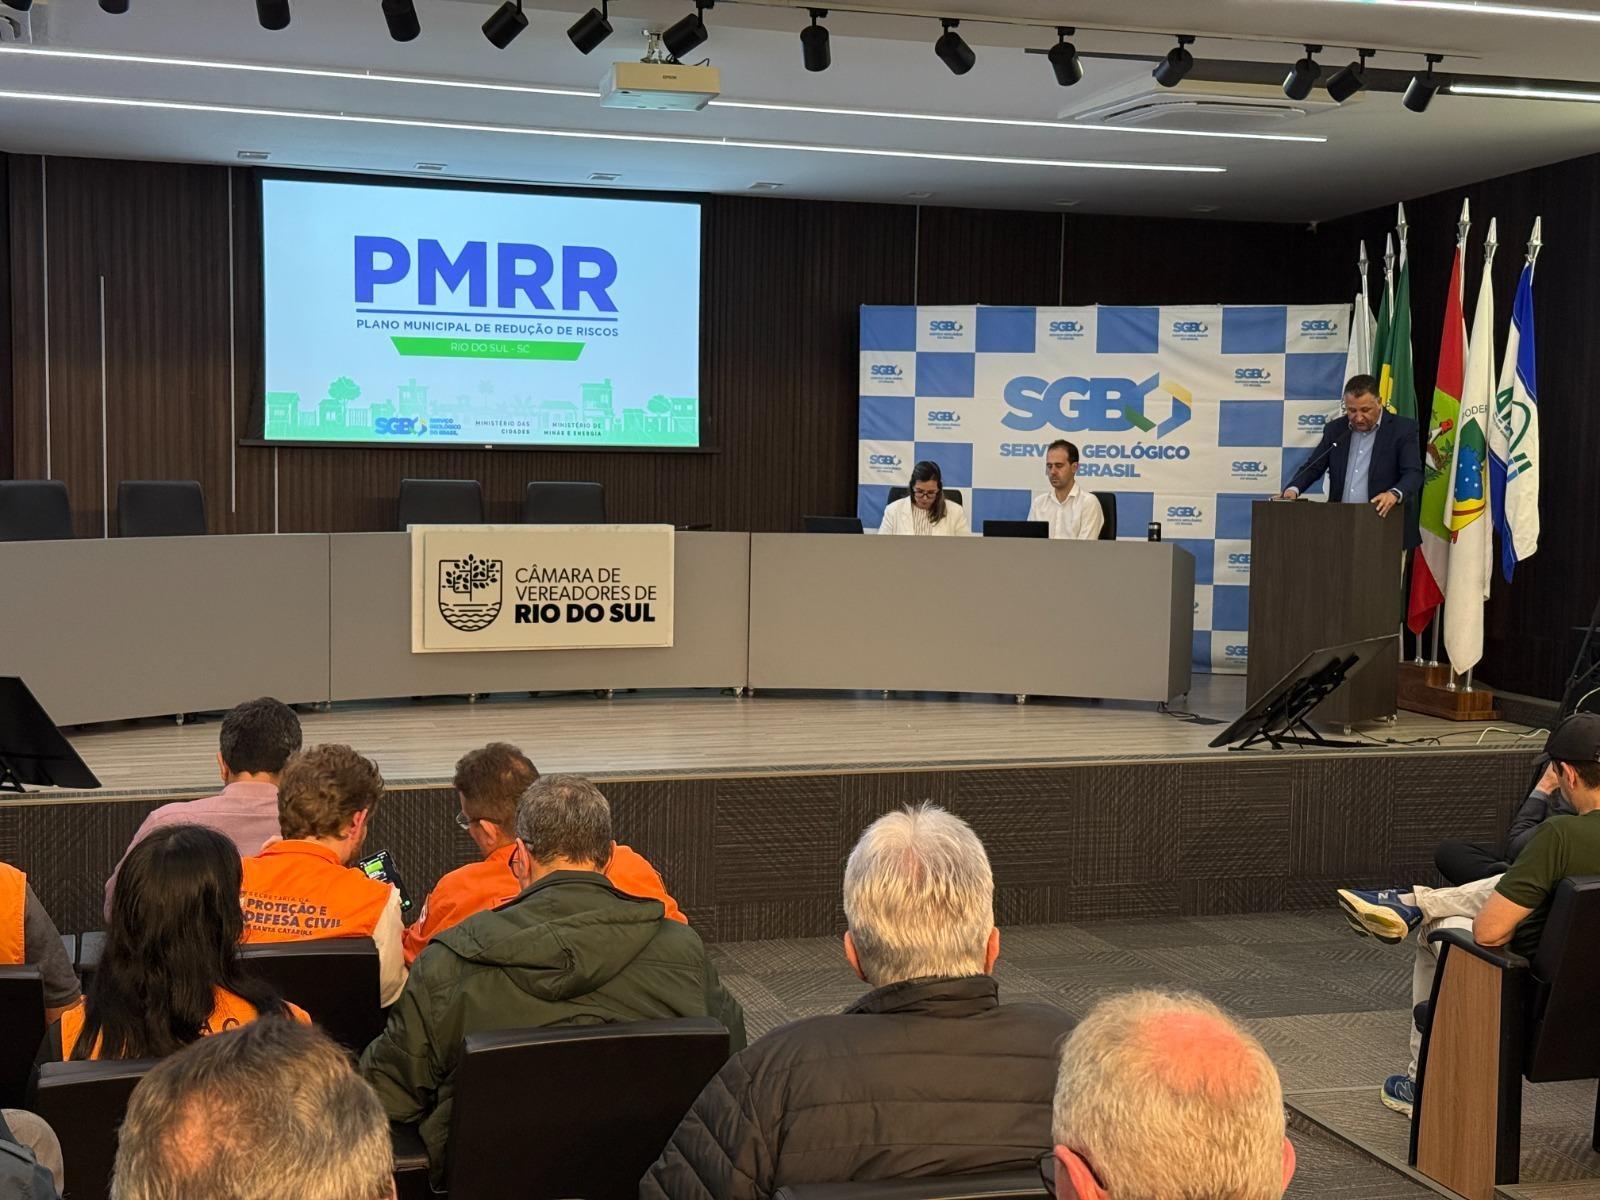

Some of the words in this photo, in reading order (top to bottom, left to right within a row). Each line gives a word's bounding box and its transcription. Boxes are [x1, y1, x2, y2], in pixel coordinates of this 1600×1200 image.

[354, 235, 620, 313] PMRR
[356, 319, 400, 330] PLANO
[403, 320, 472, 333] MUNICIPAL
[475, 323, 491, 333] DE
[494, 322, 554, 336] REDUÇÃO
[556, 326, 573, 336] DE
[576, 326, 619, 337] RISCOS
[929, 320, 955, 331] SGB
[1049, 321, 1075, 332] SGB
[1172, 321, 1200, 333] SGB
[1300, 320, 1329, 331] SGB
[450, 342, 469, 352] RIO
[471, 343, 488, 352] DO
[489, 343, 509, 353] SUL
[516, 344, 531, 354] SC
[871, 364, 896, 376] SGB
[1234, 368, 1261, 379] SGB
[1001, 376, 1145, 432] SGB
[928, 411, 954, 422] SGB
[1298, 414, 1326, 426] SGB
[374, 416, 412, 435] SGB
[475, 419, 515, 428] MINISTÉRIO
[517, 420, 530, 428] DAS
[1000, 443, 1051, 457] SERV
[1081, 441, 1191, 460] GEOLÓGICO
[869, 454, 895, 465] SGB
[1076, 463, 1141, 478] BRASIL
[1231, 461, 1258, 472] SGB
[1167, 506, 1194, 518] SGB
[515, 563, 593, 584] CÂMARA
[598, 568, 621, 583] DE
[515, 585, 631, 602] VEREADORES
[635, 585, 657, 601] DE
[515, 603, 561, 624] RIO
[566, 603, 605, 623] DO
[609, 602, 656, 623] SUL
[247, 898, 317, 916] PROTEÇÃO
[319, 905, 328, 917] E
[243, 910, 300, 928] DEFESA
[252, 925, 276, 933] SANTA
